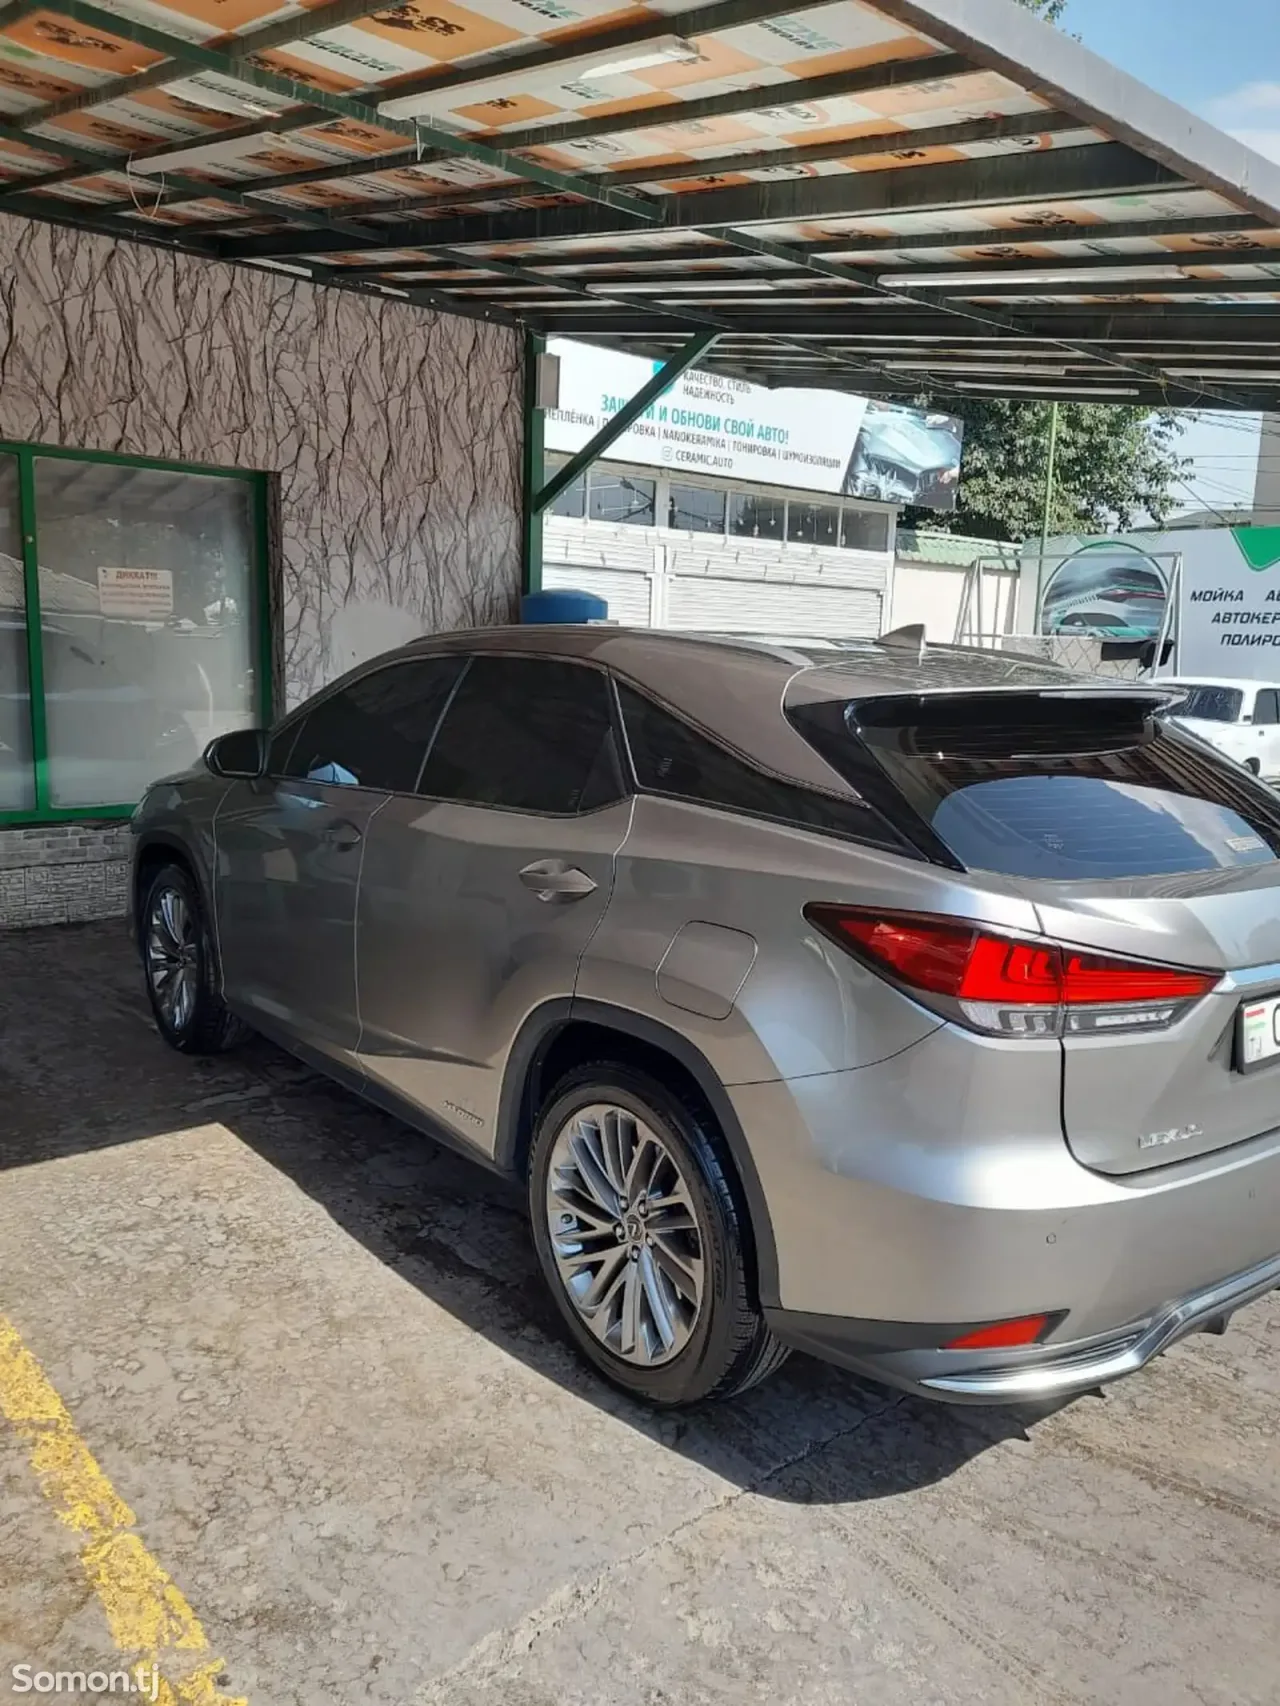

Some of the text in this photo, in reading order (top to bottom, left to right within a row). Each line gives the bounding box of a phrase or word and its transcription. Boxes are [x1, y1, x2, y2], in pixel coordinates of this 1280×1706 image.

[659, 404, 669, 422] И
[671, 408, 721, 432] ОБНОВИ
[723, 418, 755, 437] СВОЙ
[757, 426, 789, 445] АВТО!
[1190, 587, 1244, 602] МОЙКА
